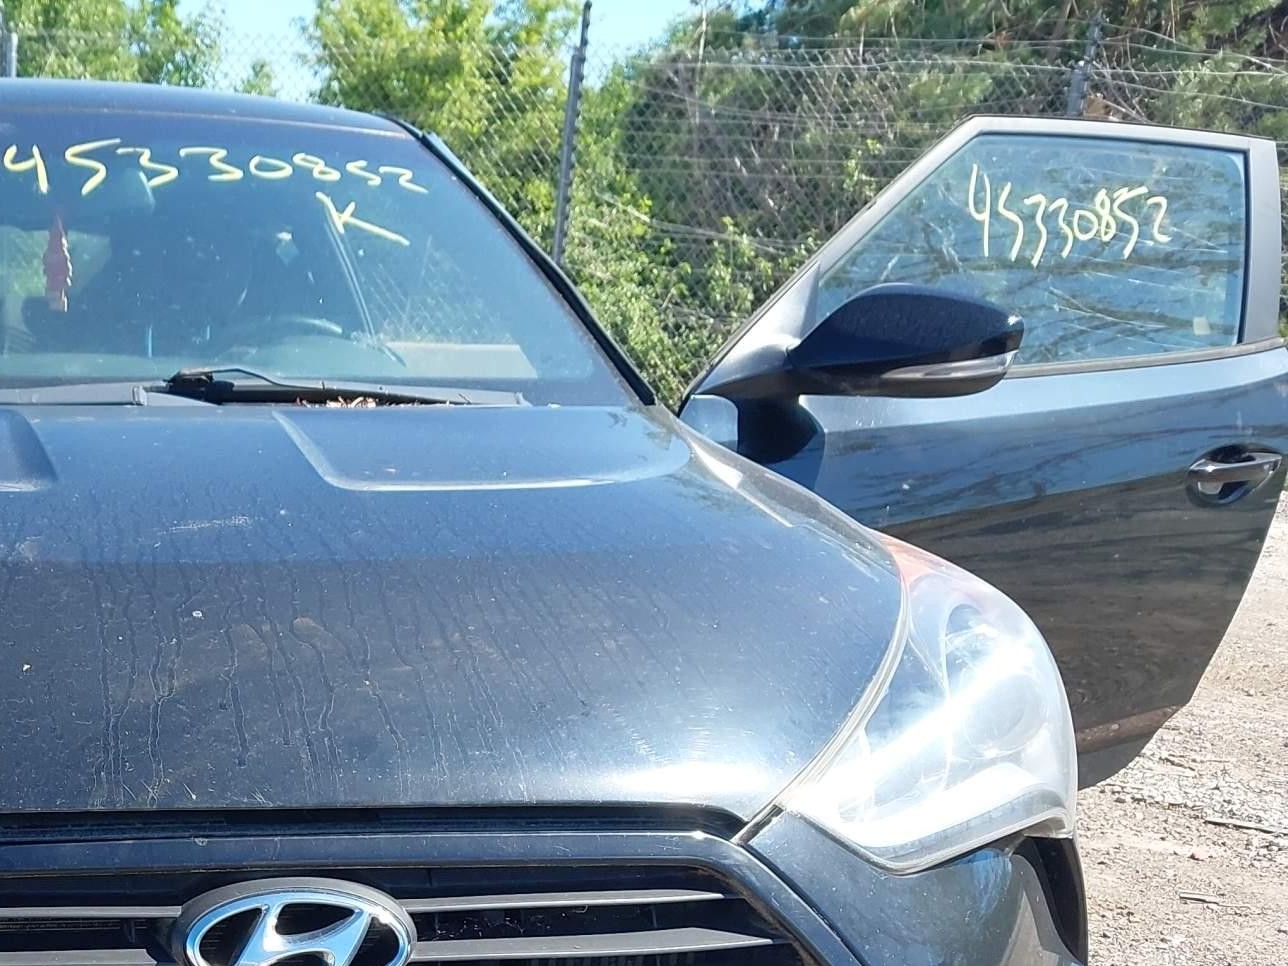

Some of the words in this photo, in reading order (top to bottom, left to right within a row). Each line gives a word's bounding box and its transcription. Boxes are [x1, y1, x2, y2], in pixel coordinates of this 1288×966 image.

[3, 138, 429, 196] 45330852
[315, 191, 411, 246] K
[968, 163, 1173, 269] 45330852
